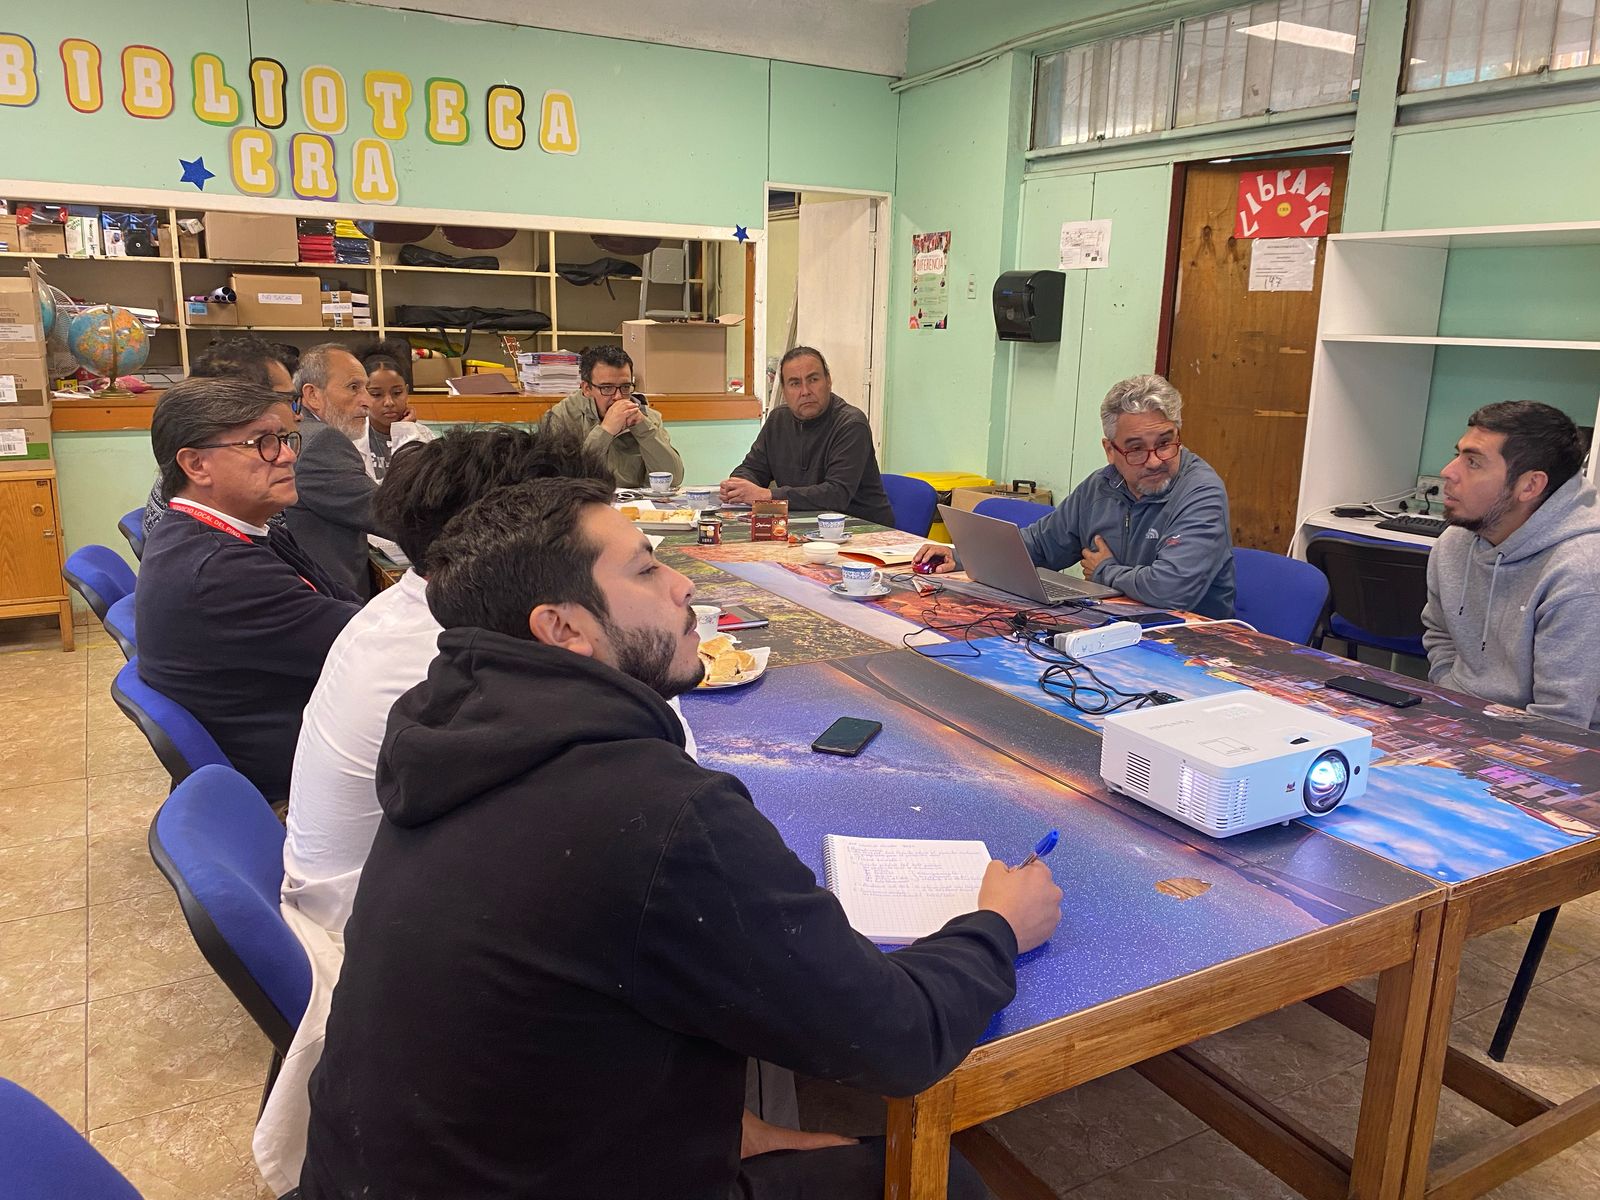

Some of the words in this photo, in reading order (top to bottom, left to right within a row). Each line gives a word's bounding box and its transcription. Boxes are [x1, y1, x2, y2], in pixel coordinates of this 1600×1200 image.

[0, 35, 577, 152] BIBLIOTECA
[229, 130, 397, 201] CRA
[194, 510, 213, 523] LOCAL
[213, 520, 225, 530] DEL
[226, 527, 241, 538] PINO
